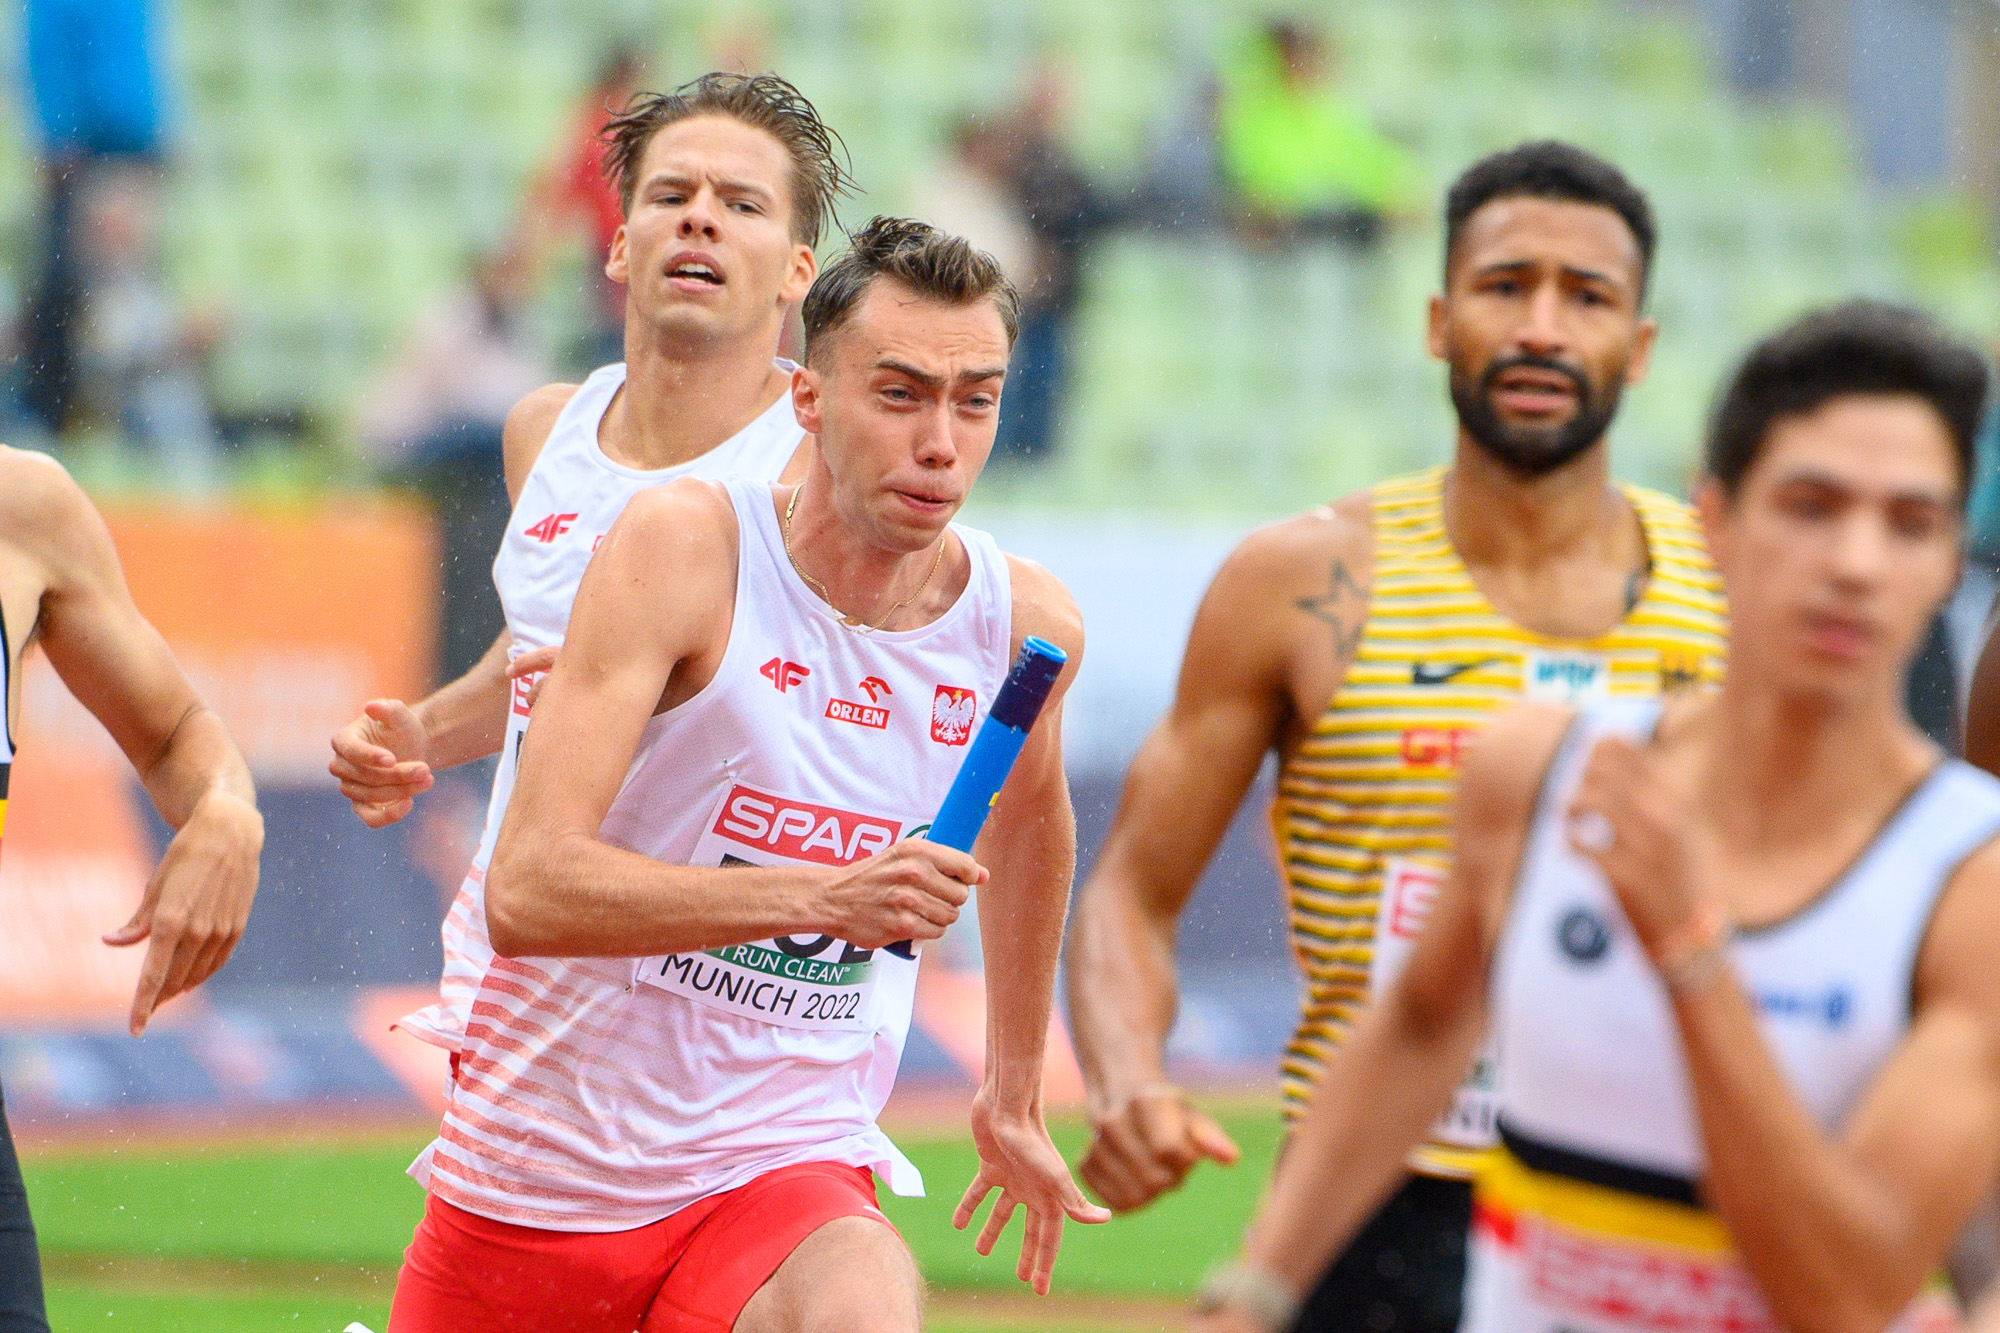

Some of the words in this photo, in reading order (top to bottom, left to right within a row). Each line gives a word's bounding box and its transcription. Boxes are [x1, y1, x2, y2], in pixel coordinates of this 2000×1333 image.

[523, 512, 580, 544] 4F
[759, 656, 811, 694] 4F
[829, 700, 886, 728] ORLEN
[723, 795, 893, 861] SPAR
[732, 945, 781, 973] RUN
[660, 954, 798, 1016] MUNICH
[801, 992, 861, 1020] 2022
